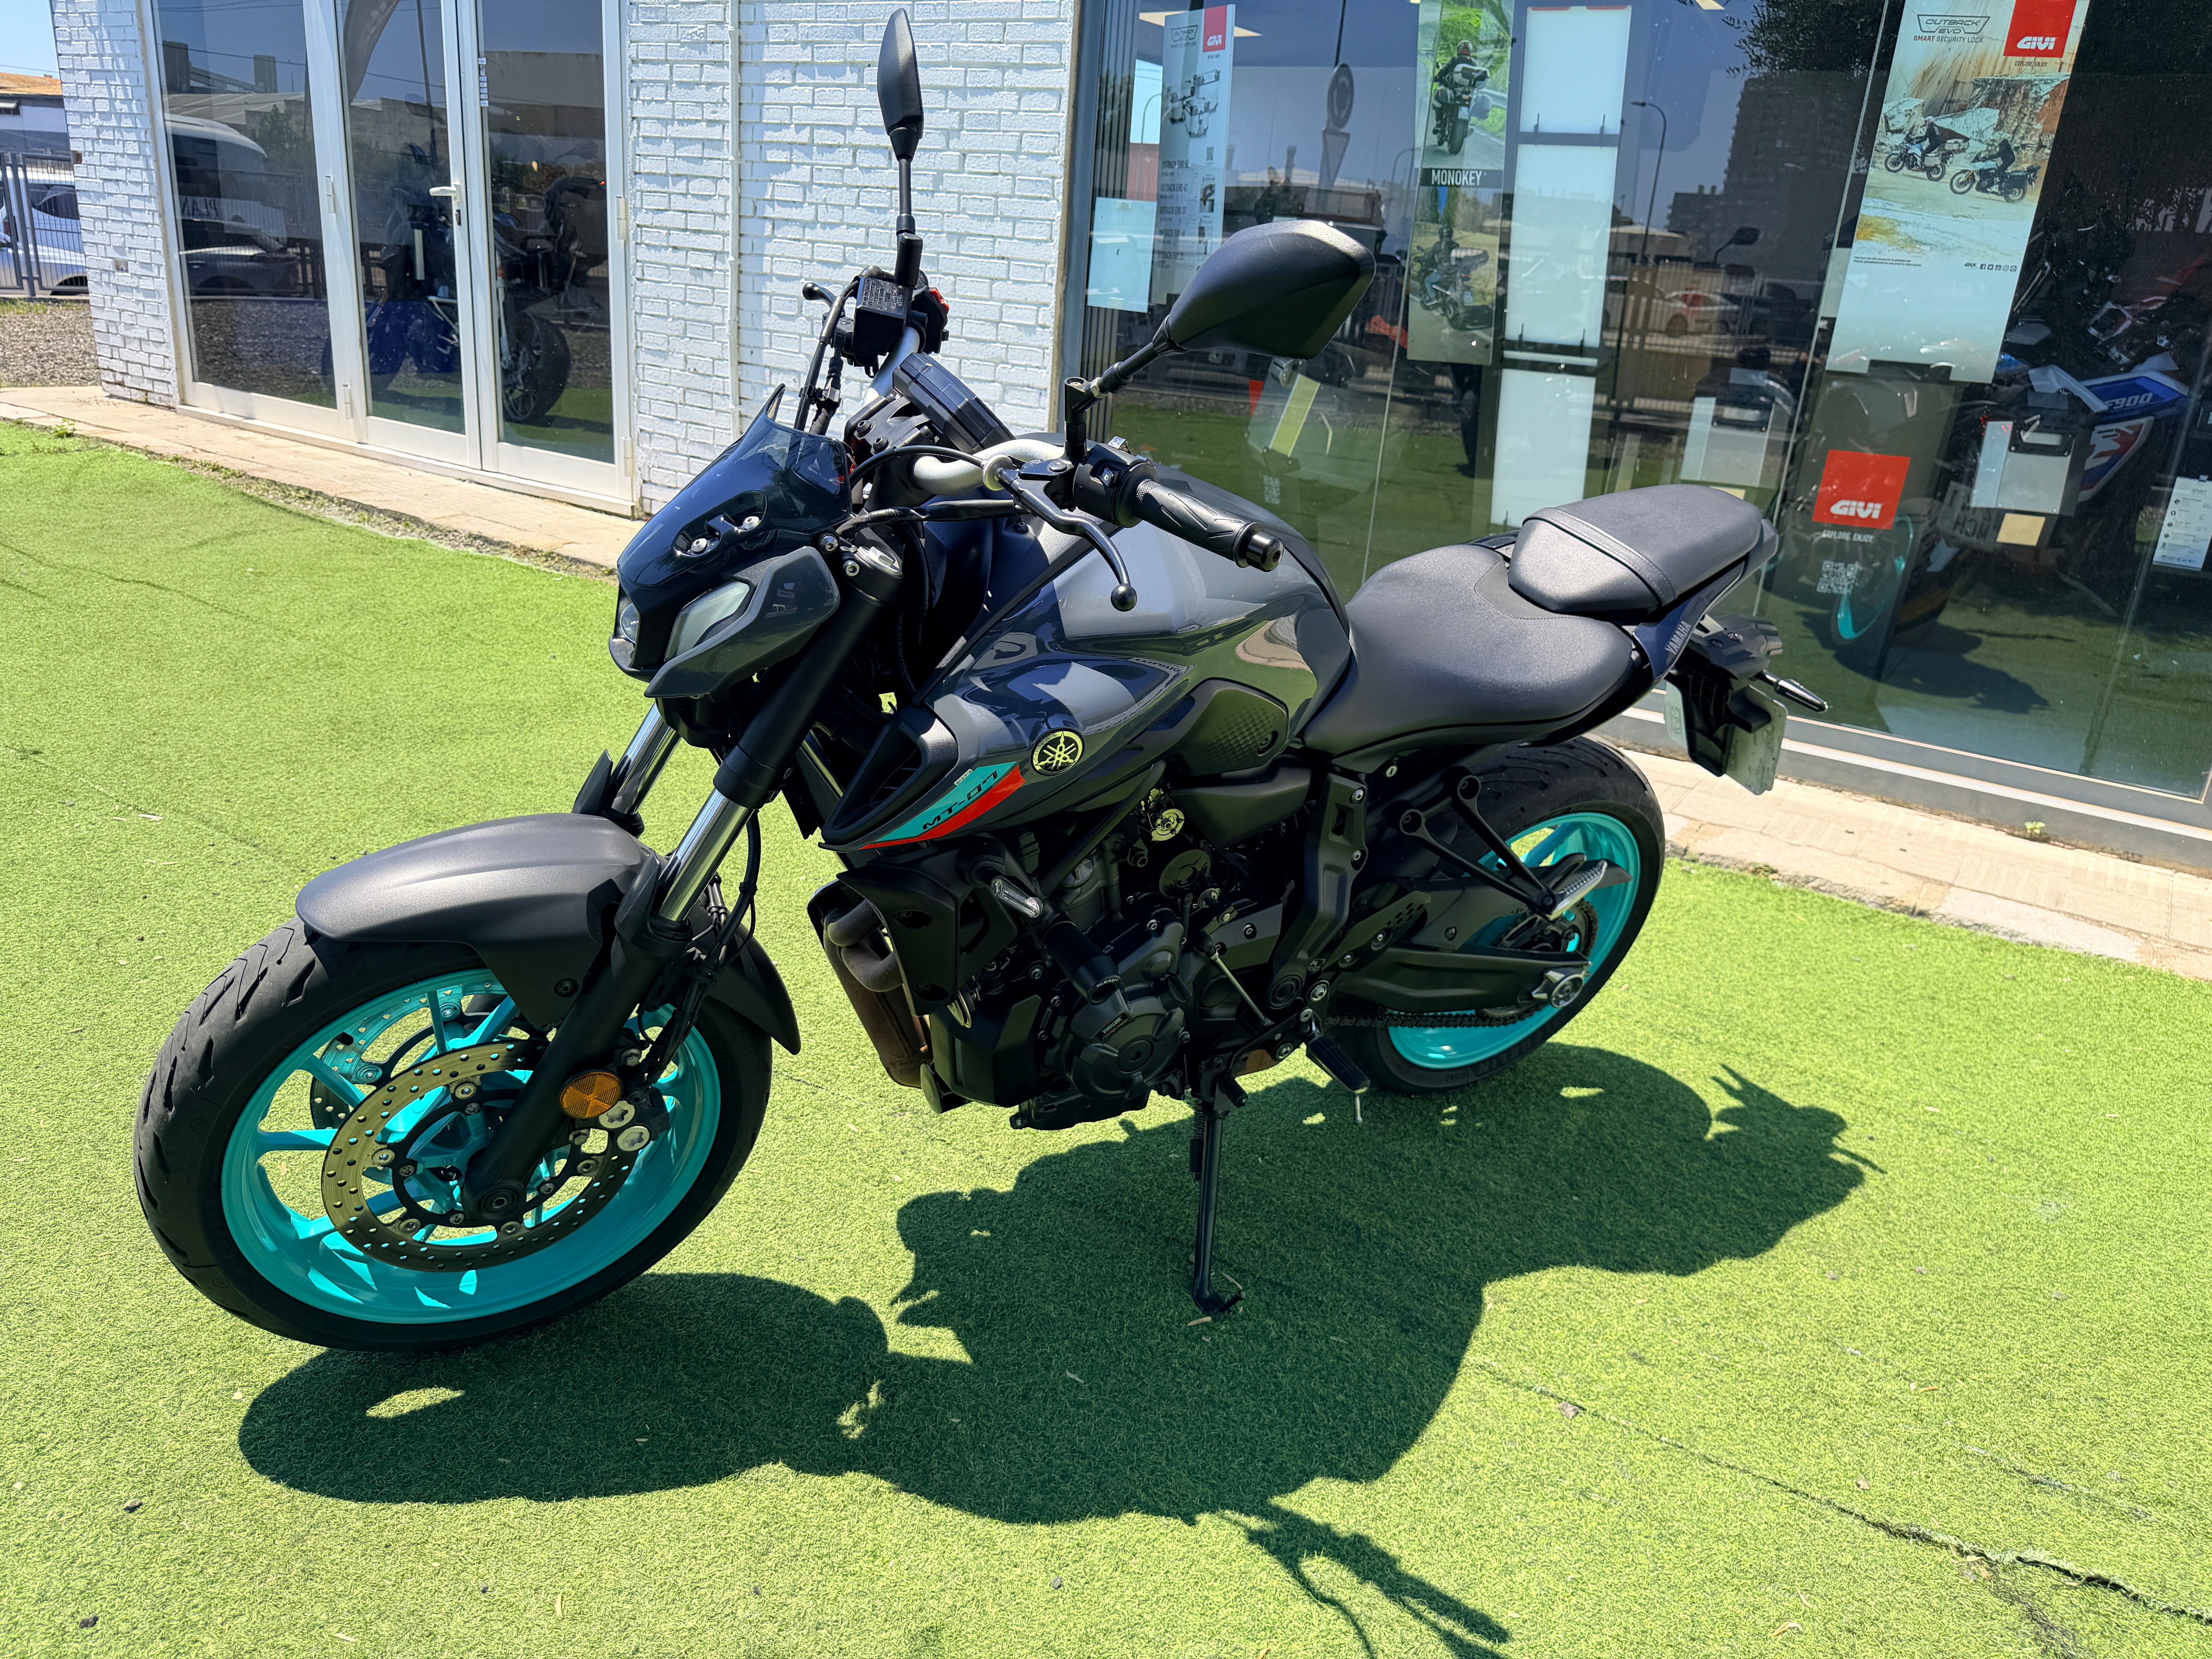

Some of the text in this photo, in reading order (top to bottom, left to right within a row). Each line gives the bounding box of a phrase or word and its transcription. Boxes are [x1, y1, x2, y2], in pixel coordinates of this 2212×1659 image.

[1207, 34, 1222, 46] GIVI
[2017, 36, 2056, 50] GIVI
[1830, 499, 1882, 519] GIVI
[1666, 621, 1691, 655] YAMAHA
[923, 770, 998, 830] MT-07
[1101, 1016, 1122, 1033] YAMALUBE
